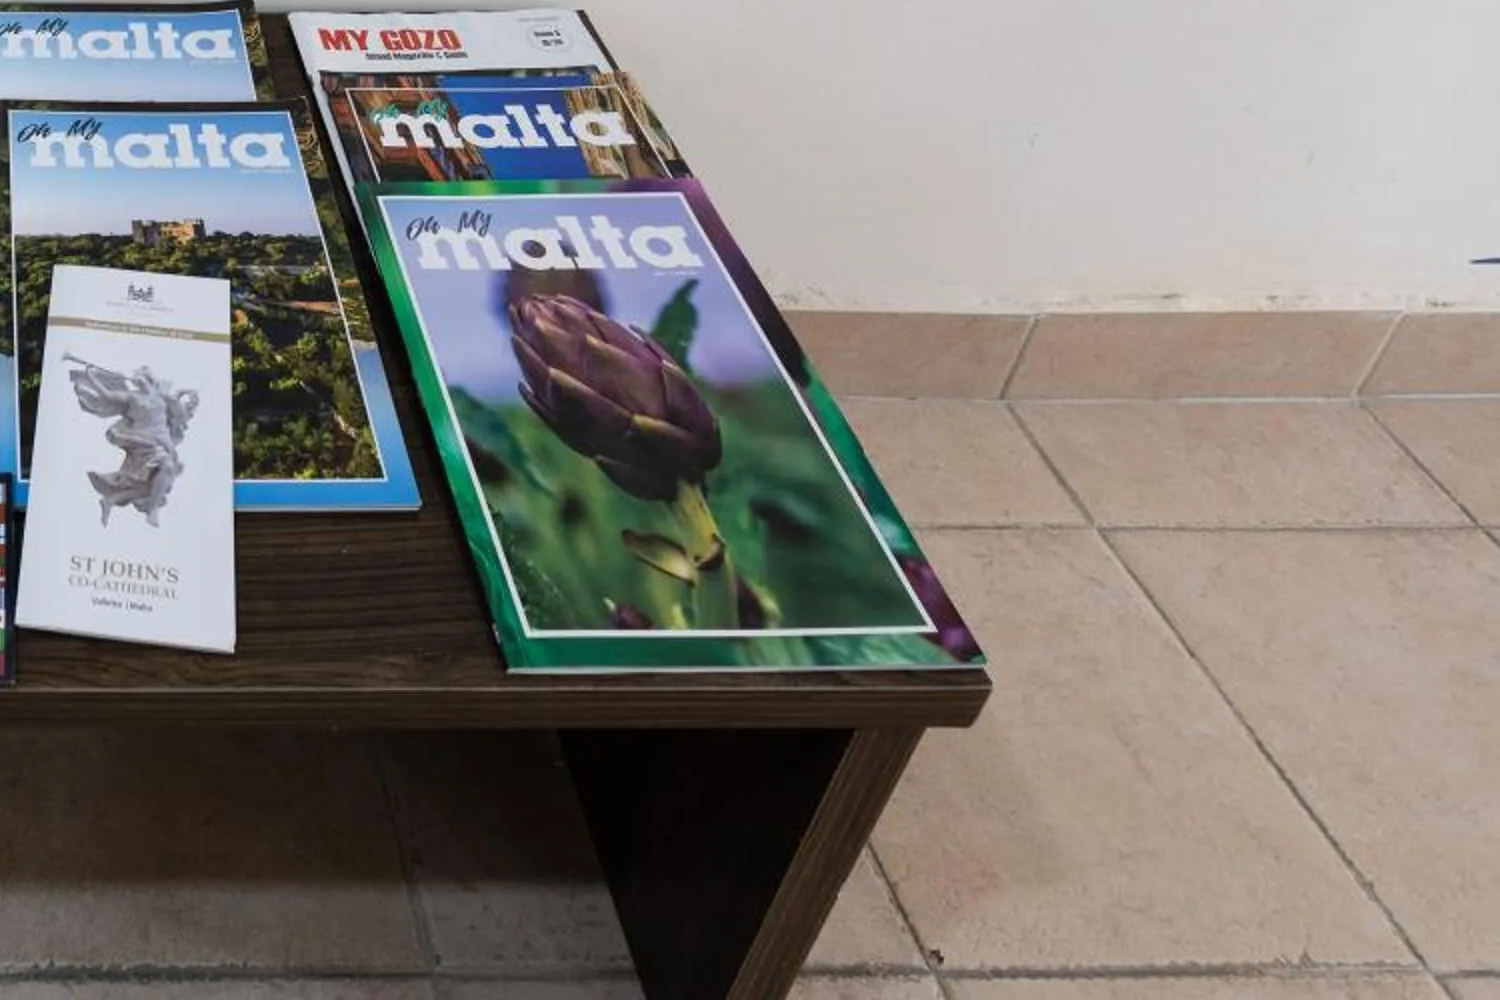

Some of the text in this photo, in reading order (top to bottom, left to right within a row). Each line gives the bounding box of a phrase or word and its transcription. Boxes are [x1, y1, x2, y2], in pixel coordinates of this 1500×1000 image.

[2, 22, 237, 60] malta
[318, 28, 463, 51] MY GOZO
[17, 117, 103, 144] Oh My
[380, 104, 637, 149] malta
[30, 123, 292, 169] malta
[405, 209, 492, 241] Oh My
[414, 215, 705, 271] malta
[69, 555, 179, 584] ST JOHN'S
[68, 573, 180, 600] CO-CATHEDRAL
